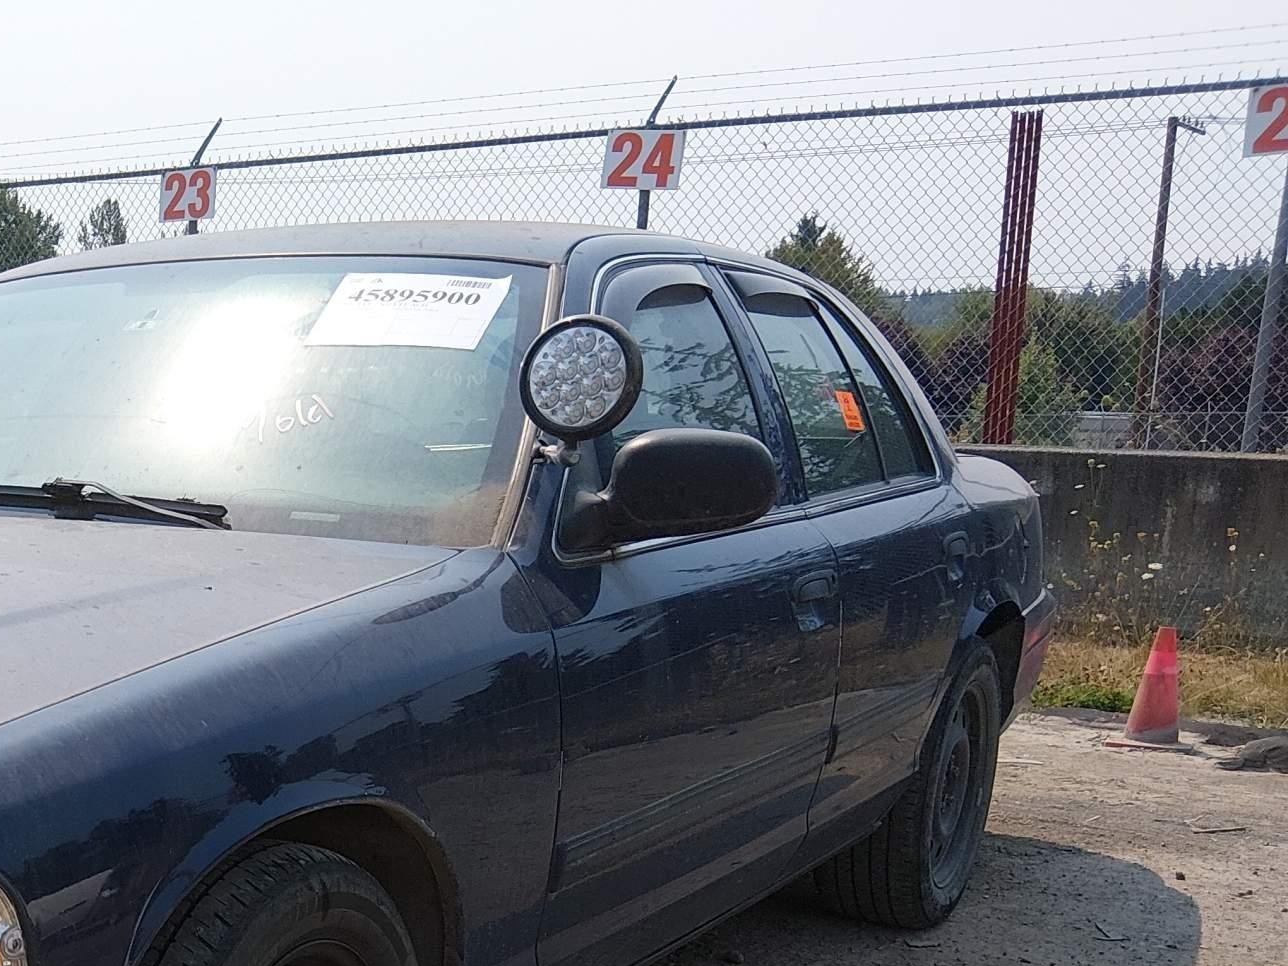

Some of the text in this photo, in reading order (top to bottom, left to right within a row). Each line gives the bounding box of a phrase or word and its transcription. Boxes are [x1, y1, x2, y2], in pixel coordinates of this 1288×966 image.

[606, 131, 676, 188] 24
[163, 168, 213, 221] 23
[347, 287, 482, 306] 45895900
